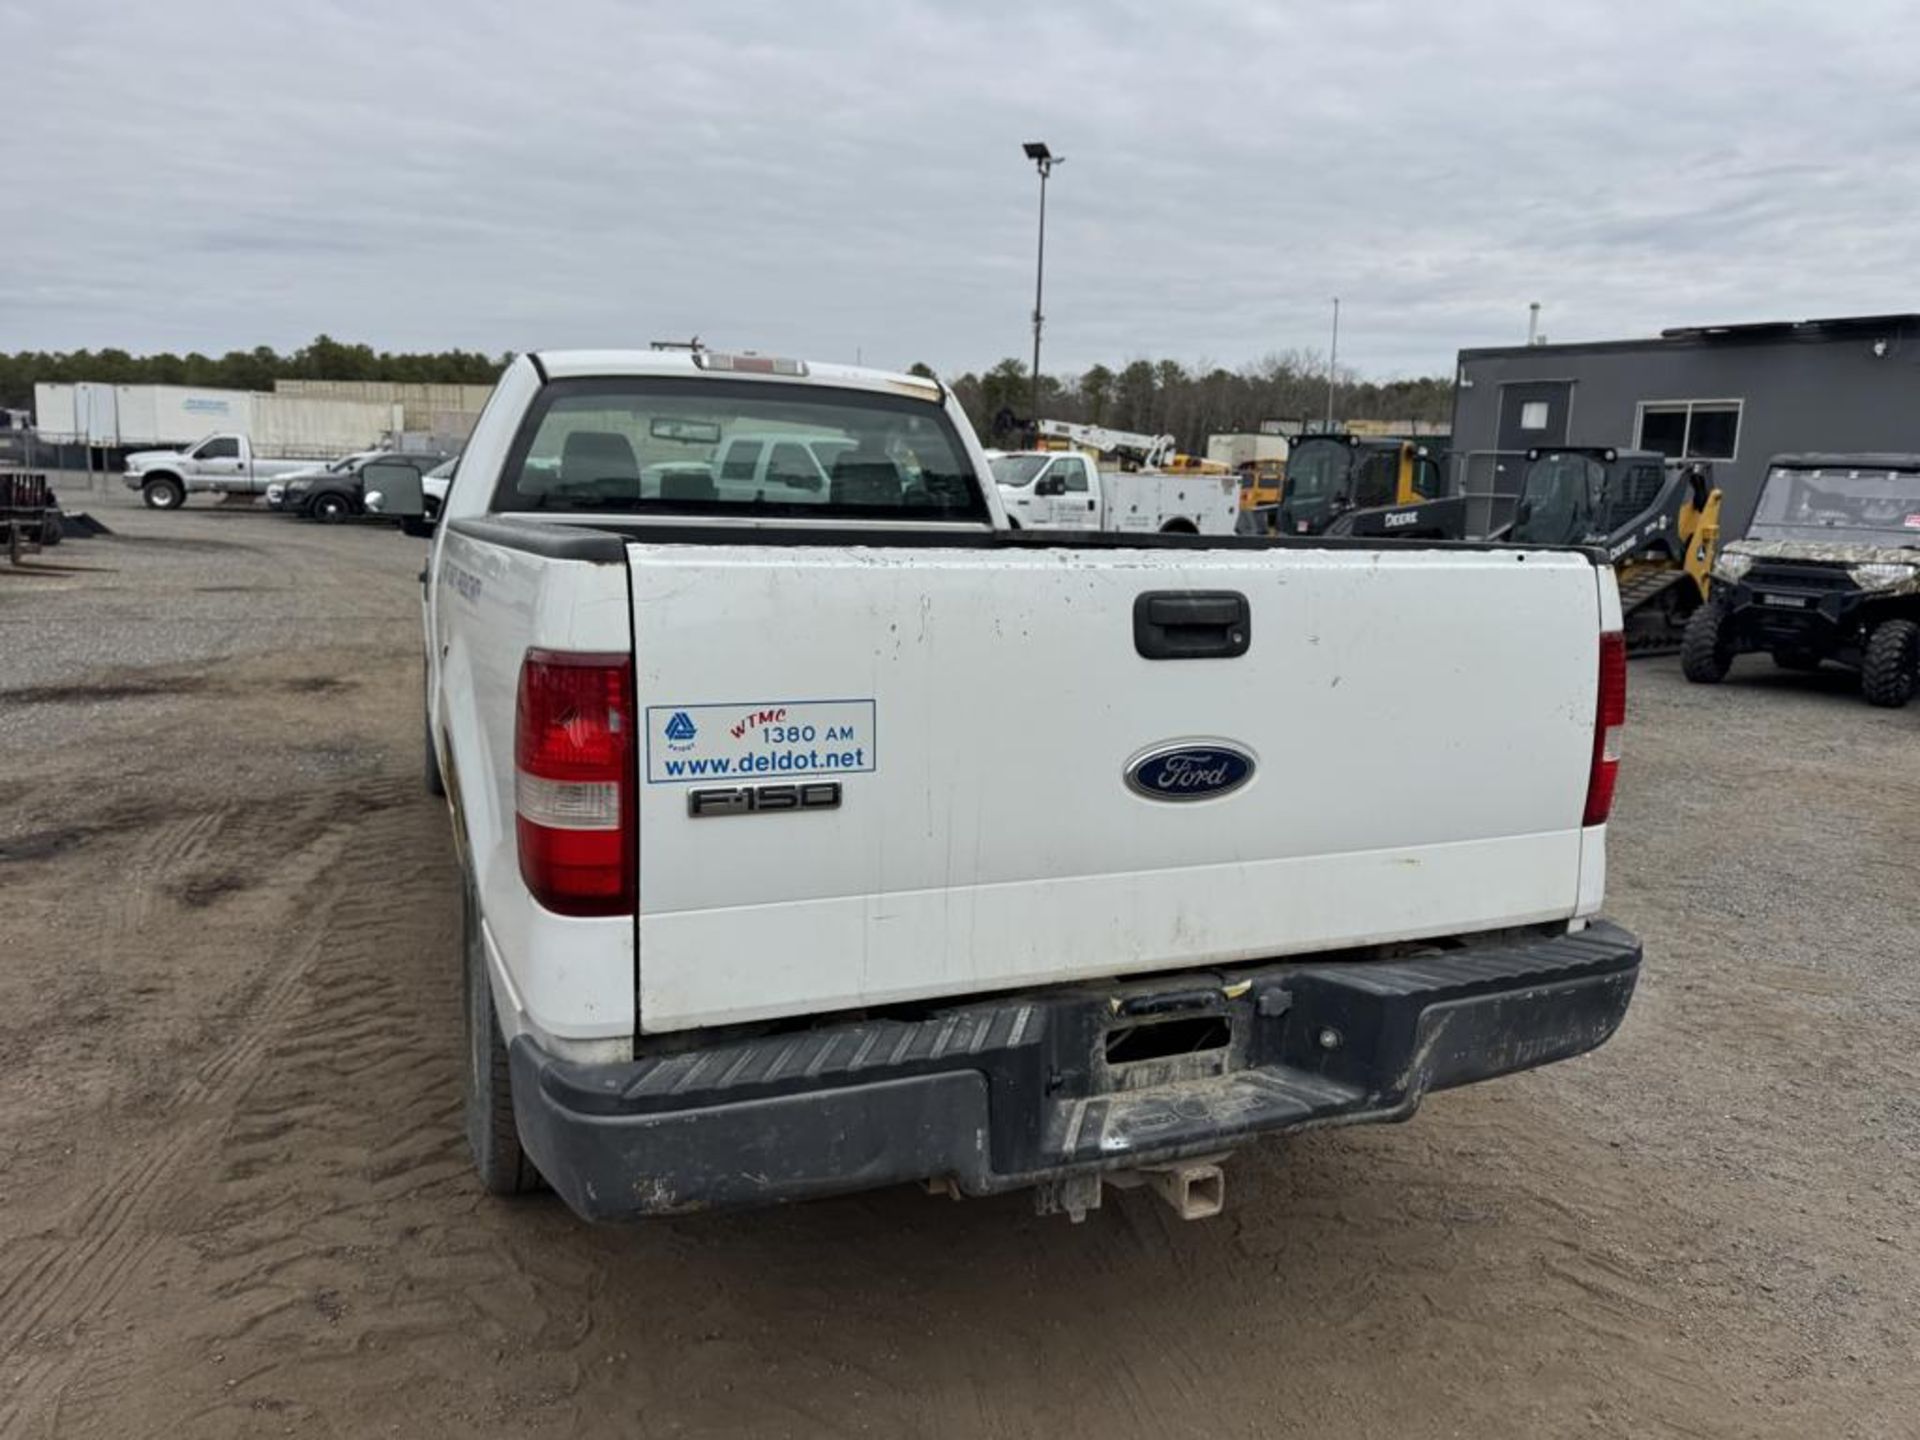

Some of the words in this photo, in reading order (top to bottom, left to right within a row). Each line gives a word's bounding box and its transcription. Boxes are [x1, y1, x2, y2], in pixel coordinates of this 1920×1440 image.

[1384, 511, 1419, 528] DEERE
[730, 708, 787, 740] WTMC
[763, 726, 815, 744] 1380
[825, 726, 854, 741] AM
[665, 748, 864, 776] www.deldot.net
[1158, 754, 1229, 788] Ford
